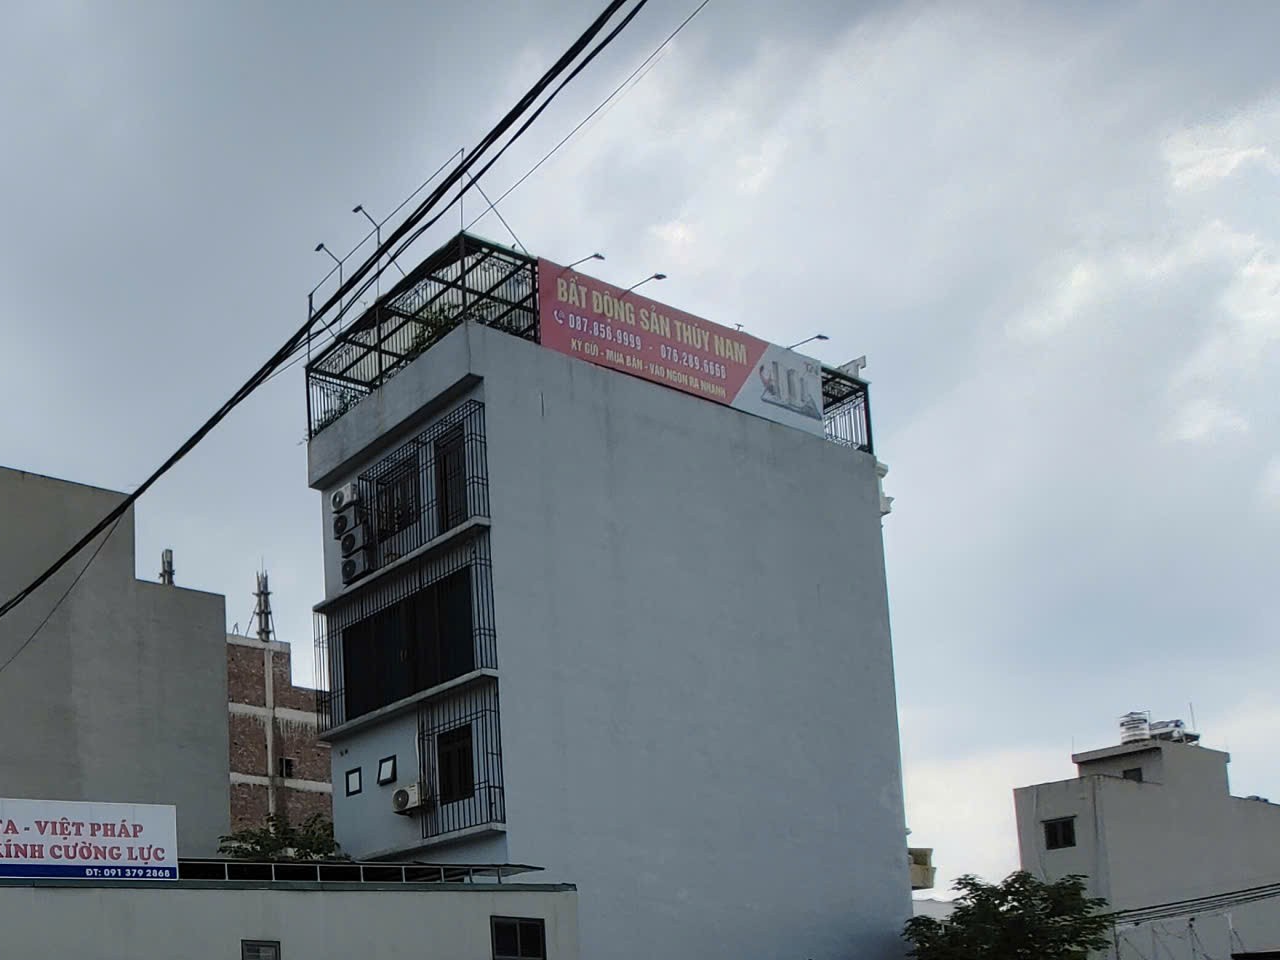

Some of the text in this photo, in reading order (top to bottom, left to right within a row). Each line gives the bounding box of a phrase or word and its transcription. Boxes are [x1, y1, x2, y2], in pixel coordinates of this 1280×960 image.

[592, 290, 635, 326] ĐỘNG
[639, 304, 671, 339] SẢN
[713, 335, 748, 365] NAM
[35, 817, 84, 840] VIỆT
[90, 819, 144, 838] PHÁP
[49, 841, 122, 860] CƯỜNG
[127, 844, 166, 865] LỰC
[104, 868, 122, 876] 091
[125, 869, 143, 877] 379
[146, 869, 170, 877] 2868
